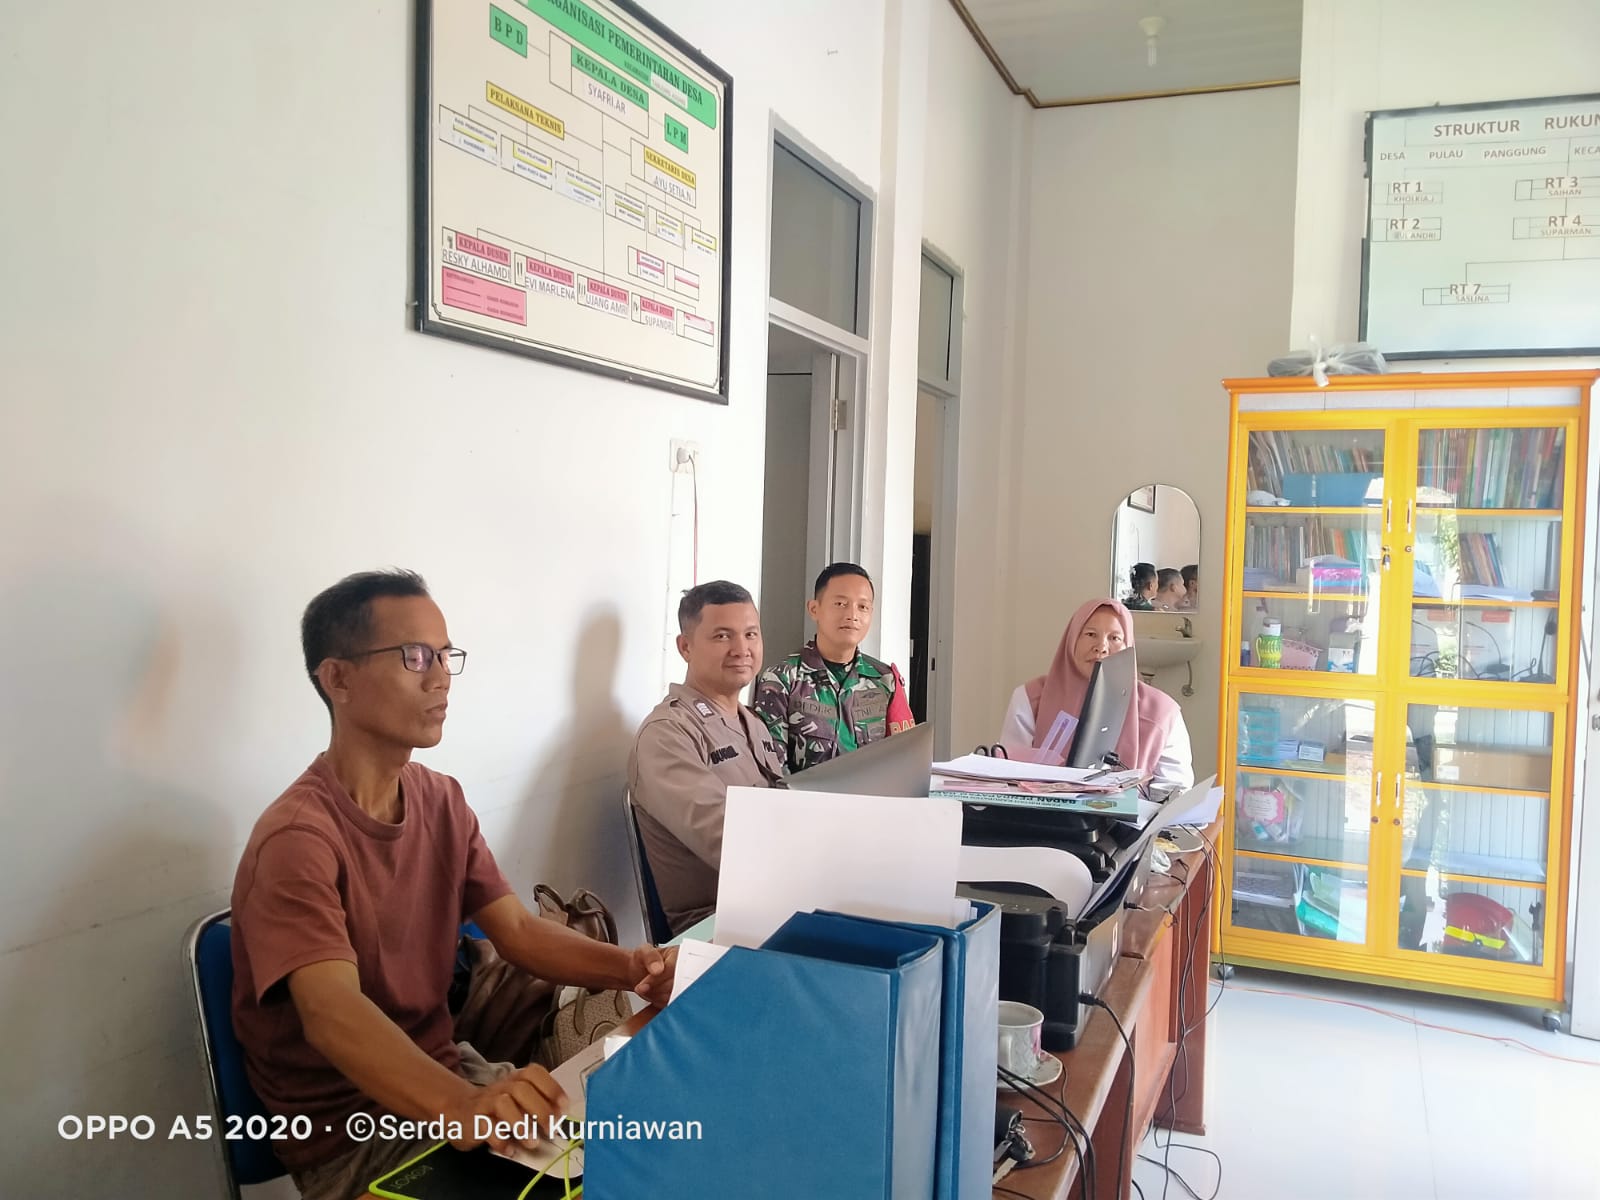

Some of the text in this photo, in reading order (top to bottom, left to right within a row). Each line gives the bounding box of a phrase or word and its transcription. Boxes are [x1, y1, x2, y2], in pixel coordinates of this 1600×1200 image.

[608, 29, 680, 89] PEMERINTAHAN
[682, 81, 703, 105] DESA
[576, 53, 617, 88] KEPALA
[620, 81, 645, 104] DESA
[490, 88, 562, 134] PELAKSANA TEKNIS
[1433, 119, 1521, 138] STRUKTUR
[1380, 152, 1406, 161] DESA
[1429, 149, 1464, 160] PULAU
[1484, 146, 1547, 159] PANGGUNG
[1392, 181, 1423, 194] RT 1
[1545, 176, 1578, 190] RT 3
[1390, 218, 1421, 230] RT 2
[1548, 215, 1582, 227] RT 4
[1541, 228, 1592, 236] SUPARMAN
[459, 236, 485, 255] KEPALA
[442, 249, 470, 268] RESKY
[471, 258, 511, 280] ALHAMDI
[529, 261, 552, 277] KEPALA
[525, 277, 576, 301] EVI MARLENA
[590, 281, 610, 296] KEPALA
[1450, 283, 1481, 295] RT 7
[586, 294, 609, 311] UJANG
